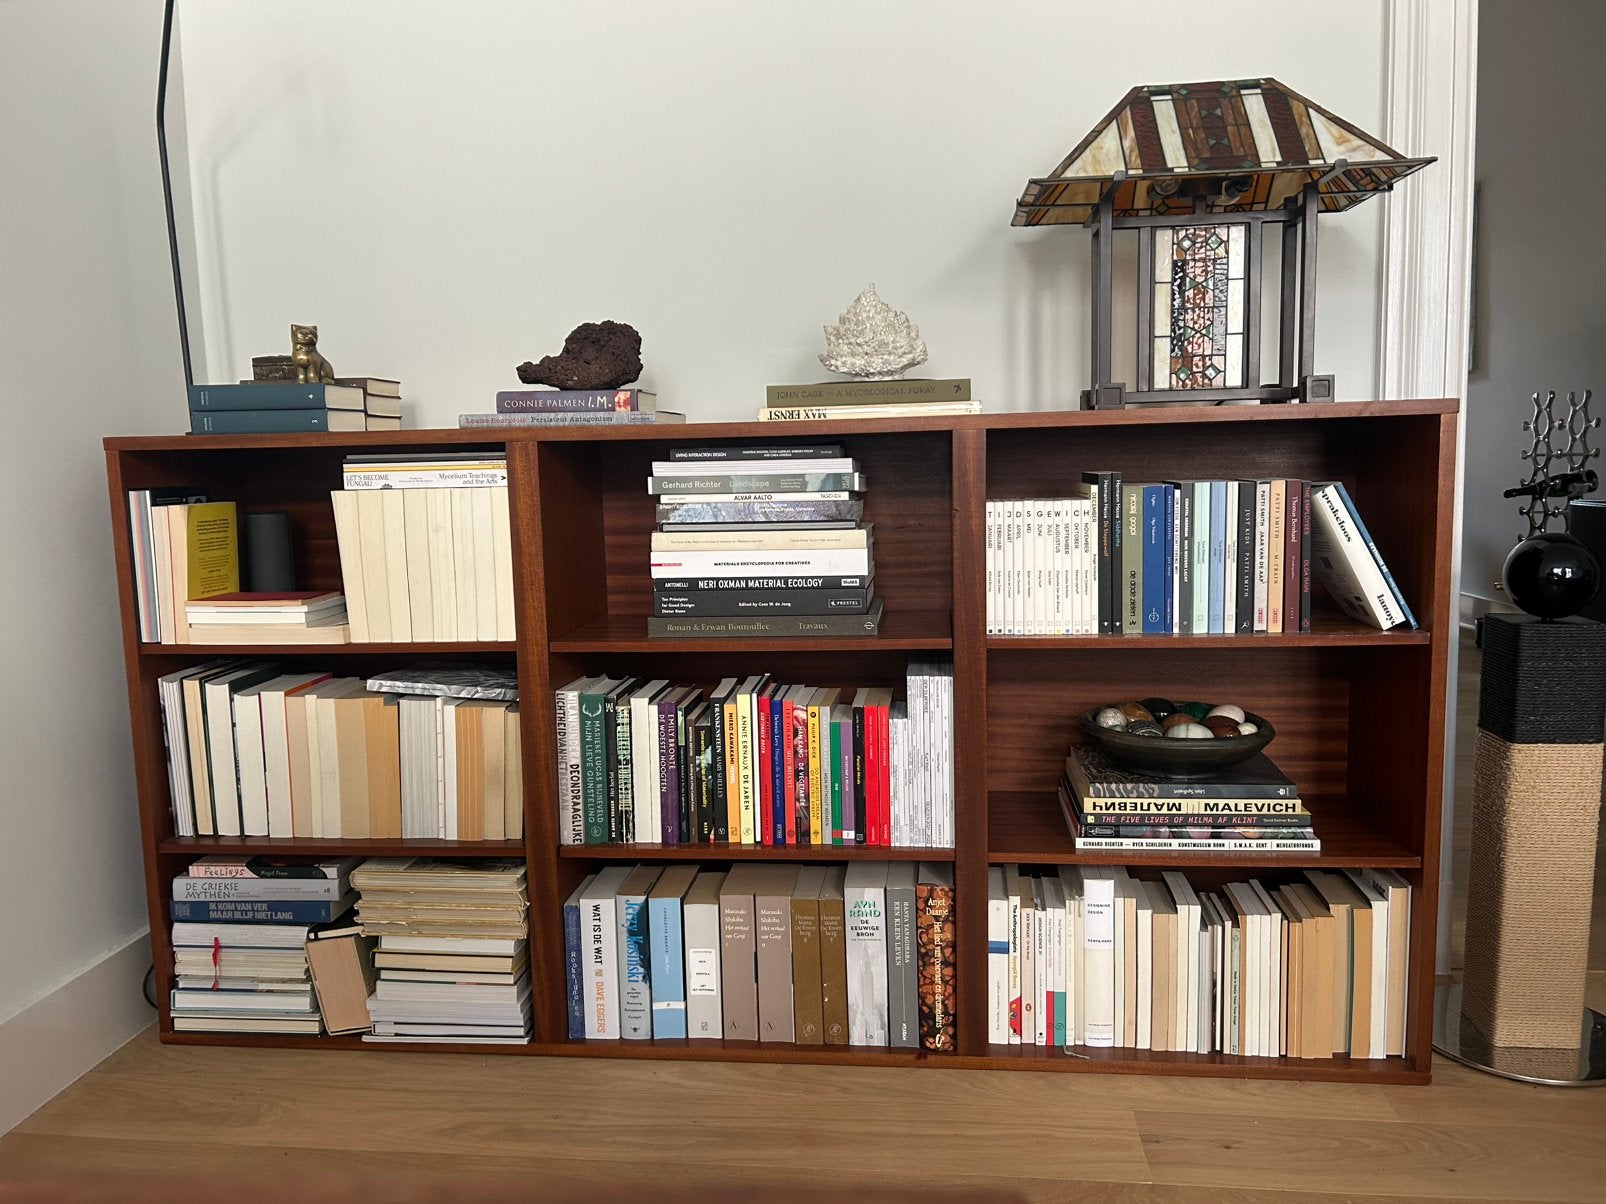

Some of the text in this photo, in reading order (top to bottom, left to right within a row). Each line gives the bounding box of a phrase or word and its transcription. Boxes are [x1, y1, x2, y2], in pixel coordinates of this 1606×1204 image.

[588, 396, 612, 408] I.M.
[768, 409, 827, 420] MAX ERNST
[662, 480, 721, 489] Gerhard Richter
[729, 480, 769, 489] Landscape
[1128, 494, 1138, 535] nicolaj gogol
[1130, 571, 1137, 579] de
[698, 580, 716, 588] NERI
[719, 580, 746, 588] OXMAN
[748, 580, 786, 588] MATERIAL
[788, 579, 822, 587] ECOLOGY
[743, 775, 749, 785] DE
[586, 771, 595, 823] GUNSTELING
[1092, 802, 1182, 811] МАЛЕВИЧ
[1204, 803, 1296, 812] MALEVICH
[202, 882, 239, 891] GRIEKSE
[853, 901, 876, 909] AYN
[928, 898, 945, 908] Anjet
[592, 904, 600, 922] WAT
[622, 900, 642, 931] Jerzy
[926, 907, 949, 917] Daanje
[594, 934, 601, 944] DE
[594, 947, 602, 965] WAT
[596, 981, 605, 1033] DAVE EGGERS
[935, 994, 943, 1028] dromedaris
